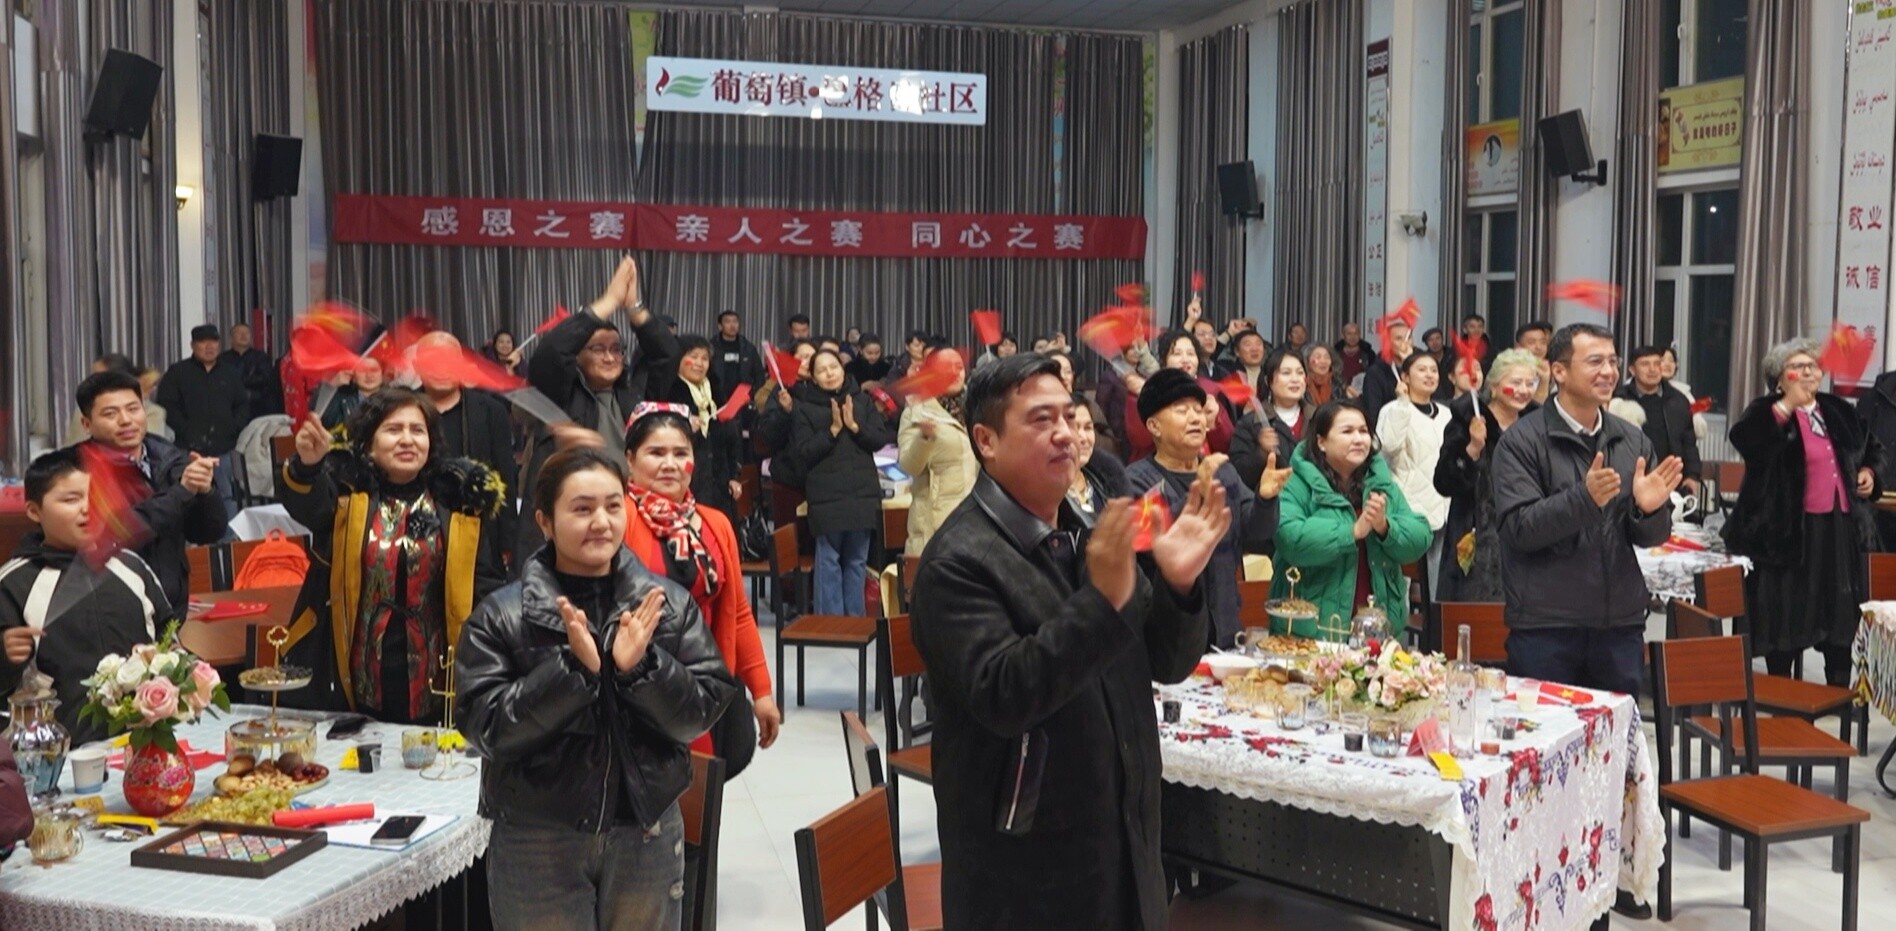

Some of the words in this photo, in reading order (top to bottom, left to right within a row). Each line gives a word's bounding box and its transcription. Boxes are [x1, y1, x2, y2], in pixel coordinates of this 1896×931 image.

[710, 69, 978, 114] 葡萄镇•格社区
[421, 206, 624, 240] 感恩之赛
[676, 214, 863, 247] 亲人之赛
[912, 222, 1084, 250] 同心之赛
[1848, 205, 1882, 231] 敬业
[1845, 264, 1881, 290] 诚信
